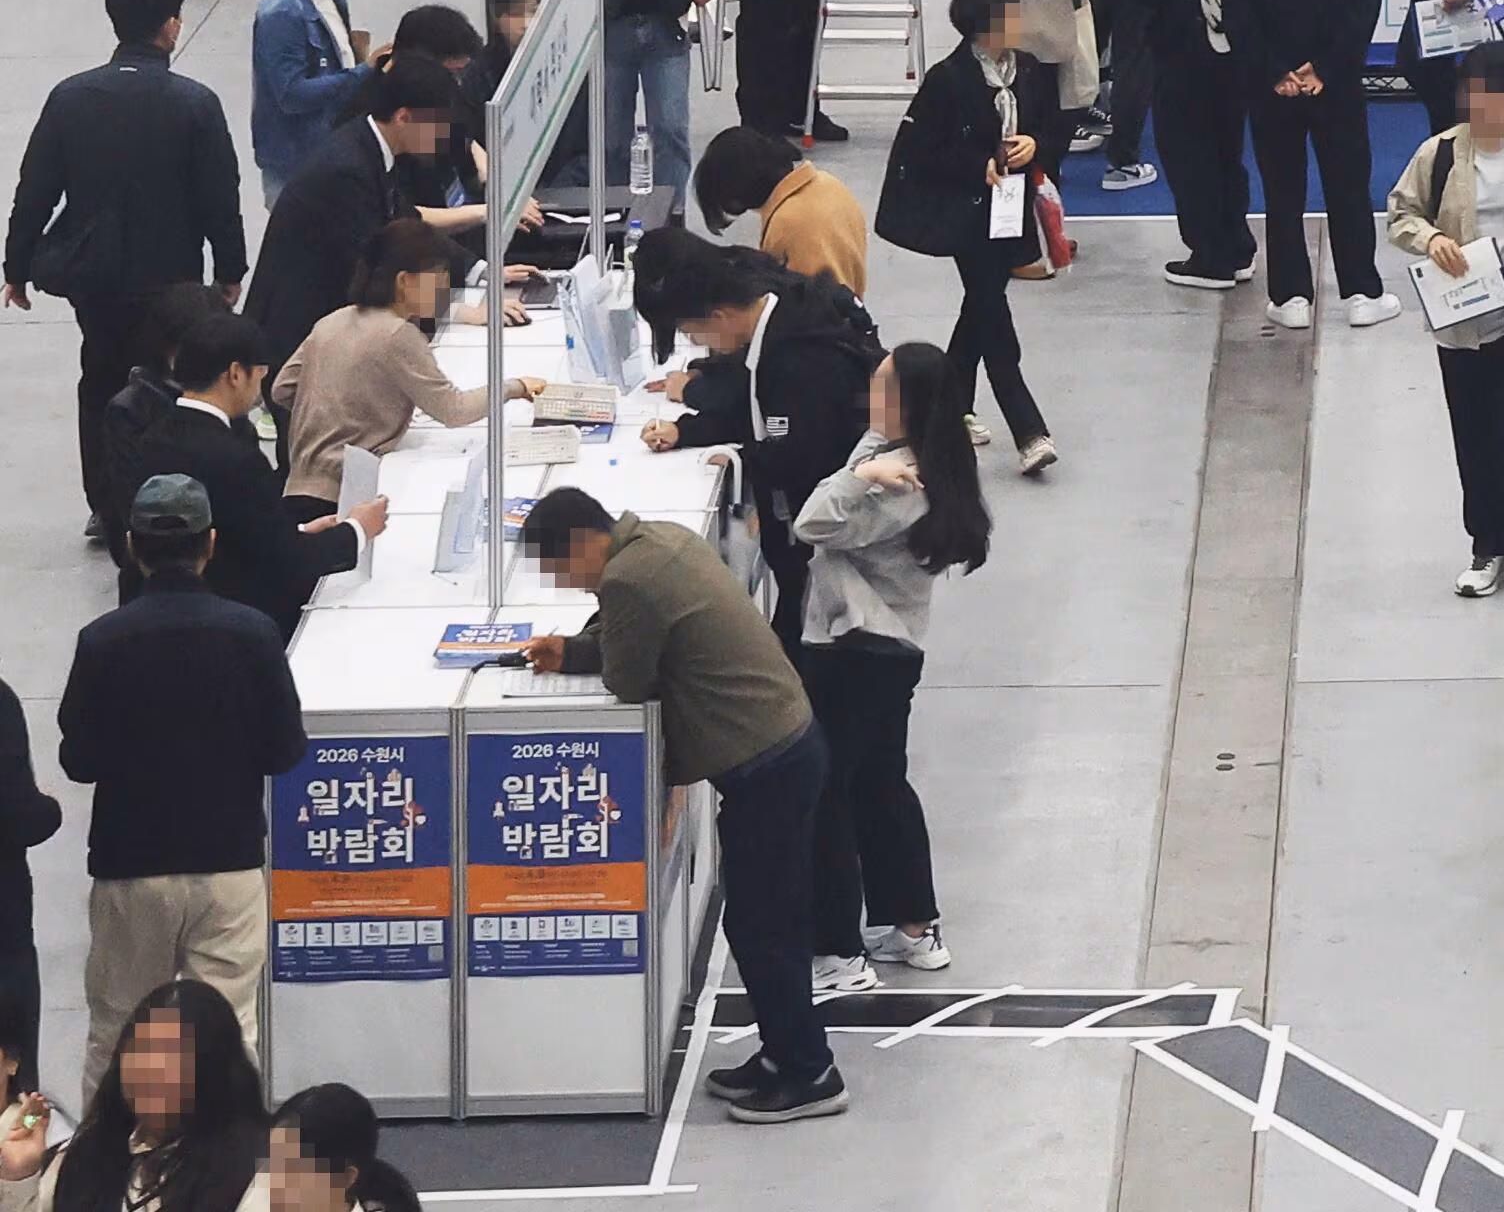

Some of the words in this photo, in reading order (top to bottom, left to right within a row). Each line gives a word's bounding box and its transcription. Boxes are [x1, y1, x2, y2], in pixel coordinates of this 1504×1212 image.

[316, 748, 359, 763] 2026
[361, 745, 404, 764] 수원시
[512, 743, 554, 758] 2026
[556, 740, 600, 760] 수원시
[307, 776, 414, 816] 일자리
[502, 771, 608, 811] 일자리
[308, 822, 414, 864] 박람회
[503, 818, 608, 860] 박람회
